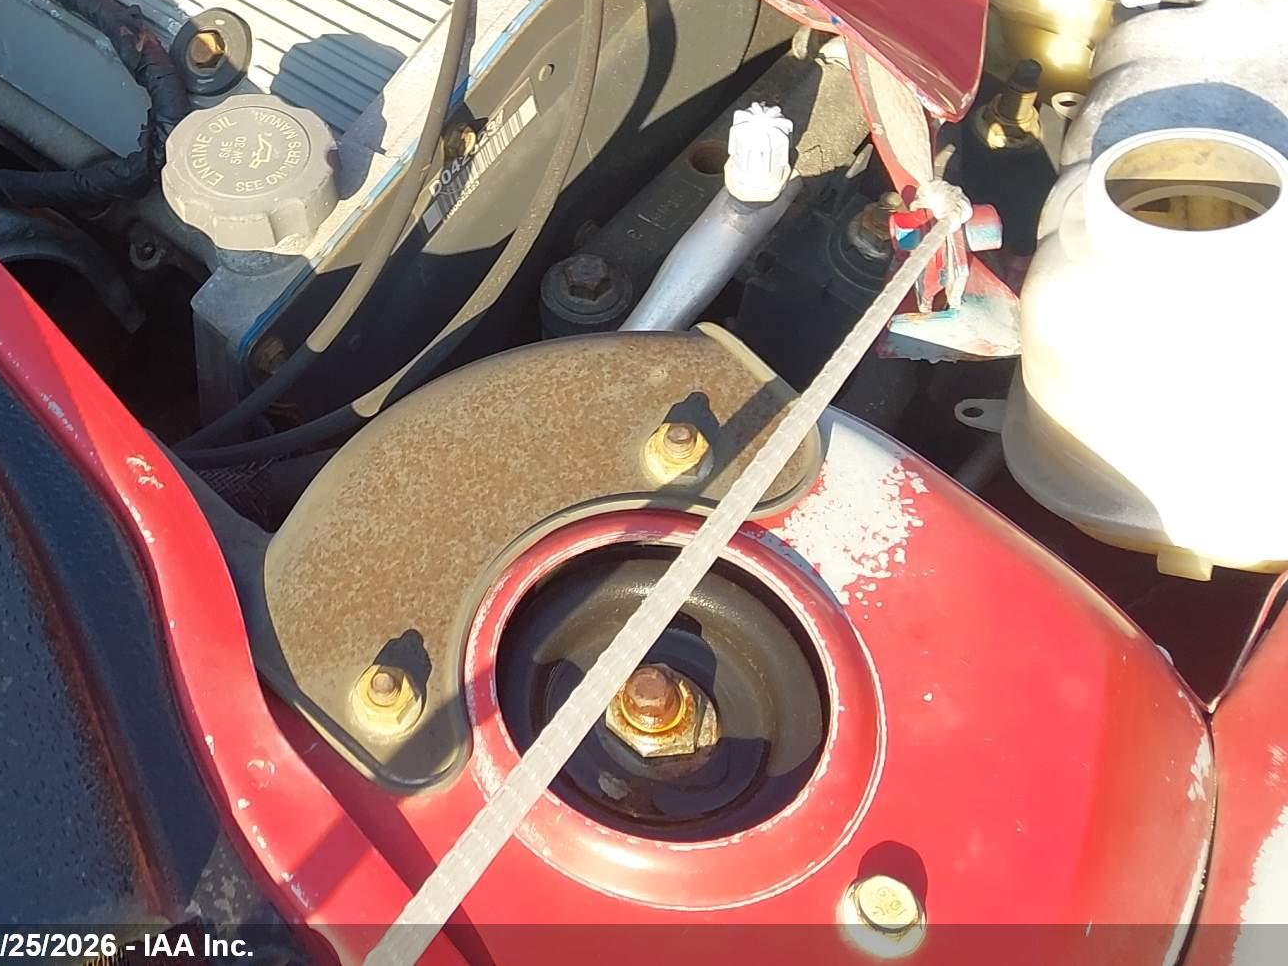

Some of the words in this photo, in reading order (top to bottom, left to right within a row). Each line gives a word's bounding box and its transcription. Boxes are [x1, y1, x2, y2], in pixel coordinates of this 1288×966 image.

[191, 134, 224, 187] ENGINE
[210, 115, 237, 133] OIL
[219, 141, 233, 160] SAE
[230, 136, 247, 165] 5W-30
[235, 180, 264, 192] SEE
